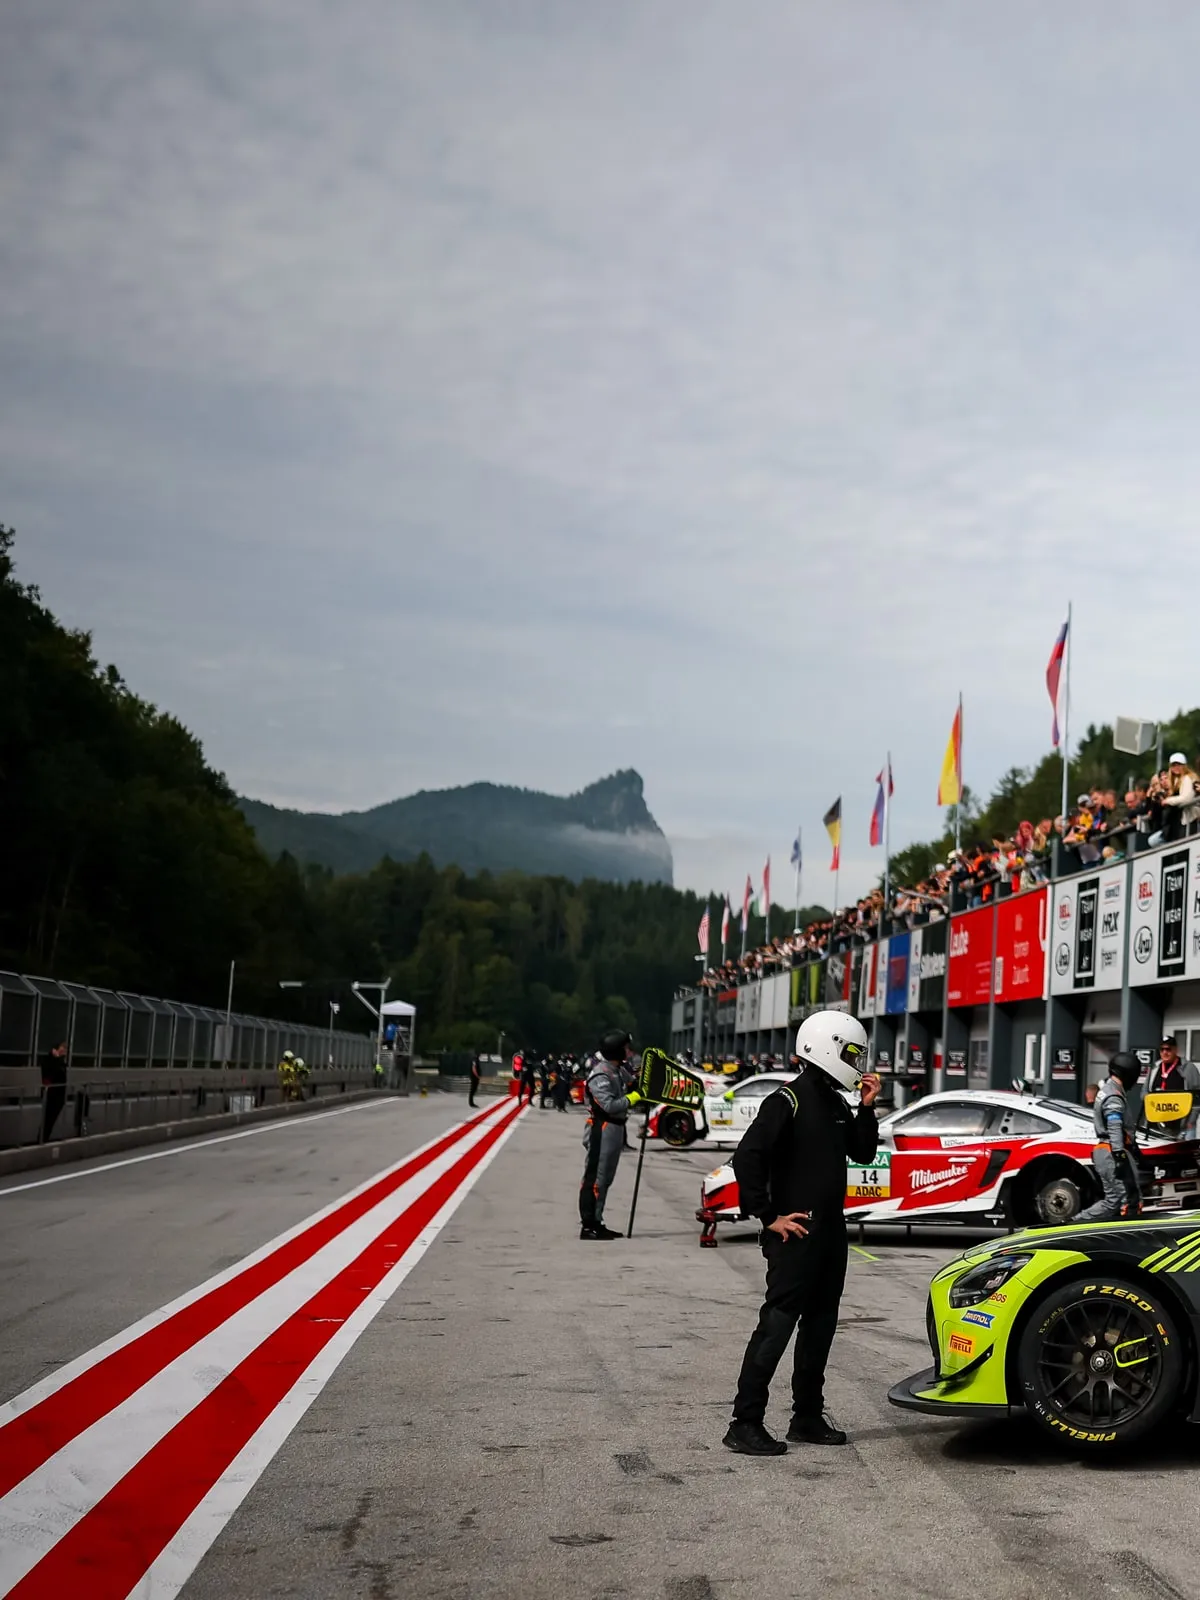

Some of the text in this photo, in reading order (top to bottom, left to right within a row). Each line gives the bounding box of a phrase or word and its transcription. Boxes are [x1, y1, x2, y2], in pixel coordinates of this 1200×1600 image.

[1167, 875, 1182, 892] TEAM
[1102, 911, 1120, 934] HRX
[1164, 907, 1181, 924] WEAR
[1155, 1103, 1180, 1113] ADAC
[861, 1170, 879, 1185] 14
[908, 1164, 968, 1189] Milwaukee
[855, 1186, 882, 1197] ADAC
[1082, 1285, 1152, 1312] P ZERO
[949, 1334, 973, 1354] PIRELLI
[1051, 1419, 1117, 1442] PIRELLI
